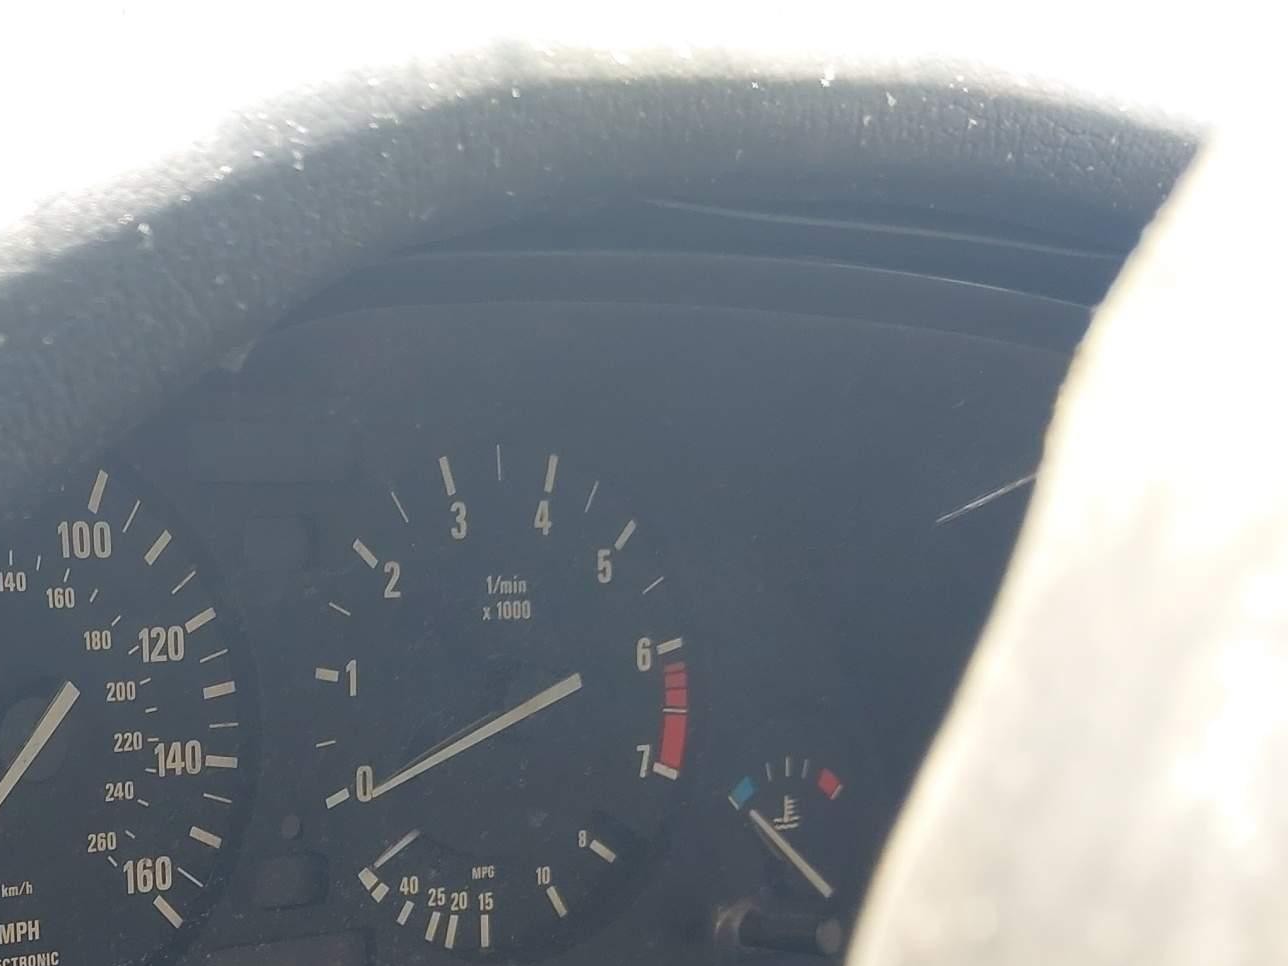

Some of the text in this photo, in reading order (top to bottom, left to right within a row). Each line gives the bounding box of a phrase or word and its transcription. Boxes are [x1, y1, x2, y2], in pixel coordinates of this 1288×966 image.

[450, 501, 468, 540] 3
[534, 500, 552, 536] 4
[57, 520, 112, 559] 100
[597, 549, 612, 584] 5
[383, 560, 401, 599] 2
[486, 575, 527, 595] 1/min
[46, 587, 75, 609] 160
[496, 600, 531, 620] 1000
[83, 630, 112, 651] 180
[139, 625, 185, 663] 120
[636, 637, 652, 672] 6
[345, 659, 357, 697] 1
[106, 680, 136, 702] 200
[113, 731, 143, 753] 220
[155, 740, 202, 778] 140
[636, 743, 651, 778] 7
[105, 781, 134, 802] 240
[356, 765, 374, 802] 0
[87, 831, 117, 853] 260
[578, 829, 587, 848] 8
[123, 855, 172, 895] 160
[471, 865, 495, 880] MPG
[535, 866, 551, 885] 10
[1, 881, 33, 898] km/h
[399, 875, 419, 895] 40
[427, 887, 446, 907] 25
[450, 891, 468, 912] 20
[478, 891, 494, 911] 15
